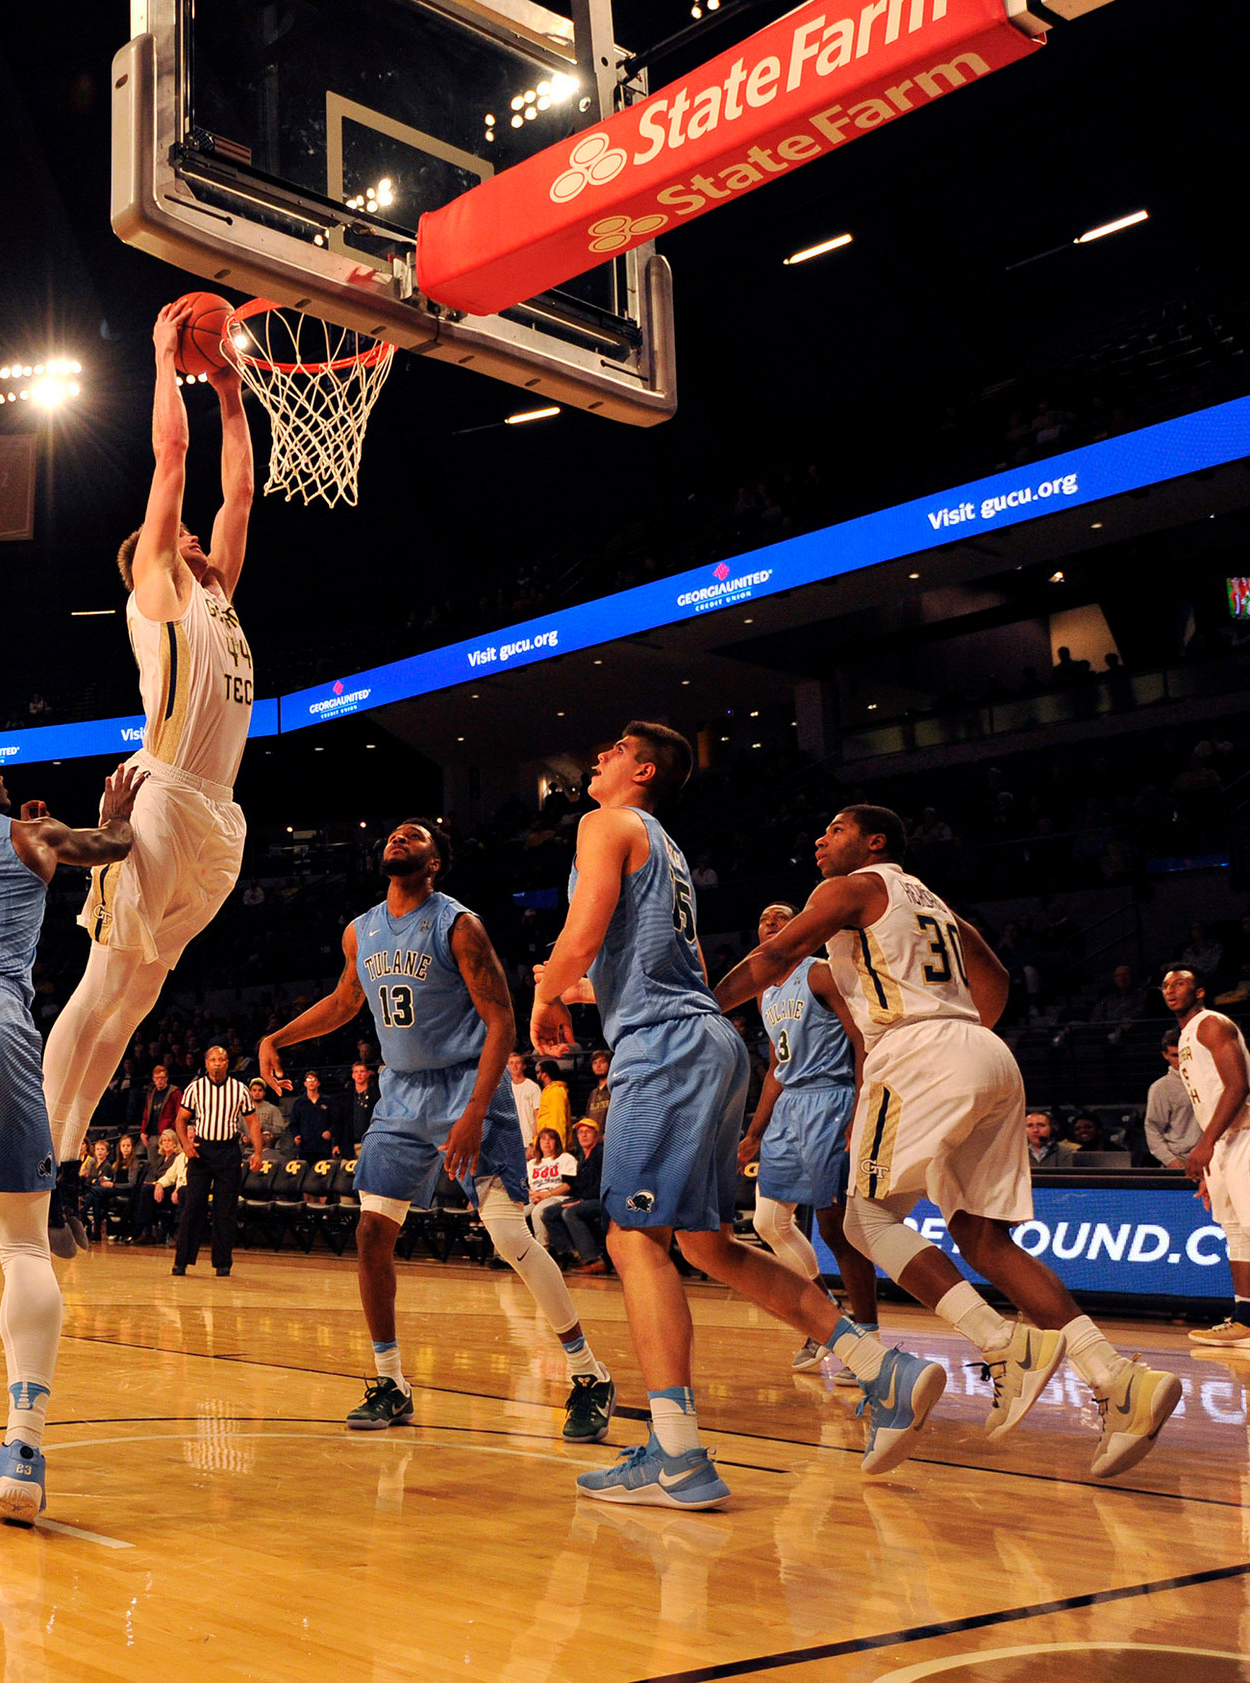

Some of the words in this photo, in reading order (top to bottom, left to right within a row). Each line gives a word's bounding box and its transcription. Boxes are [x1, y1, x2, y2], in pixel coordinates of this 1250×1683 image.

[633, 52, 781, 165] State
[786, 0, 948, 91] Farm
[656, 138, 822, 217] State
[811, 51, 992, 144] Farm
[928, 502, 975, 531] Visit
[980, 472, 1079, 519] gucu.org
[695, 598, 722, 612] CREDIT
[725, 591, 752, 603] UNION
[467, 646, 497, 668] Visit
[499, 630, 558, 661] gucu.org
[364, 949, 433, 982] TULANE
[379, 984, 415, 1028] 13
[776, 1028, 792, 1064] 3
[860, 1157, 891, 1180] GT
[15, 1463, 32, 1476] 23
